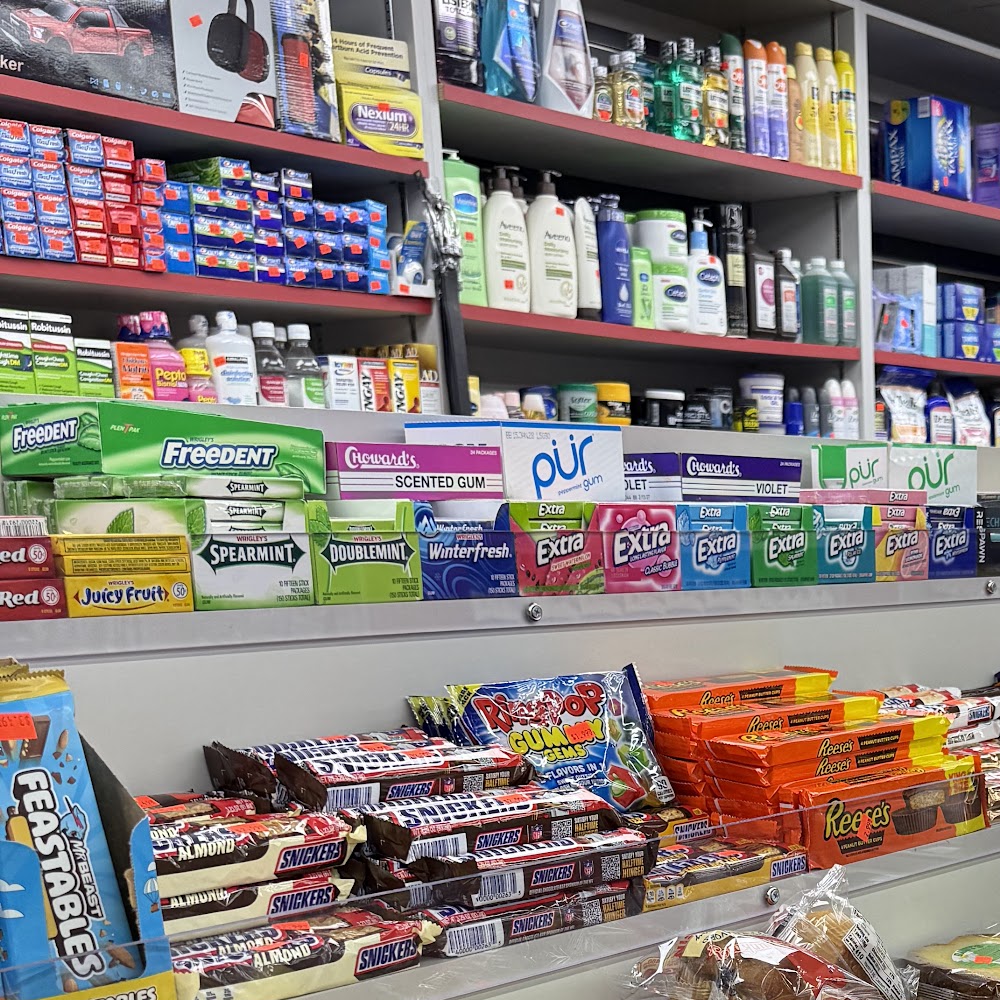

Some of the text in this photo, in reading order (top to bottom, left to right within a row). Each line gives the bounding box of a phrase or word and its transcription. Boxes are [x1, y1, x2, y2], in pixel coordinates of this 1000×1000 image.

[355, 46, 404, 59] Acid Prevention
[366, 42, 394, 52] Frequent
[364, 66, 392, 76] Capsules
[357, 104, 408, 122] Nexium
[32, 125, 57, 135] Colgate
[71, 131, 97, 141] Colgate
[32, 161, 58, 170] Colgate
[69, 165, 94, 175] Colgate
[4, 188, 32, 198] Colgate
[37, 193, 63, 203] Colgate
[7, 223, 33, 232] Colgate
[31, 322, 72, 335] Robitussin
[76, 348, 111, 359] Robitussin
[154, 368, 187, 383] Pepto
[229, 482, 266, 494] SPEARMINT
[395, 475, 486, 489] SCENTED GUM
[583, 474, 604, 492] gum
[756, 484, 788, 495] VIOLET
[890, 492, 908, 502] Extra
[229, 506, 263, 518] SPEARMINT
[539, 503, 566, 516] Extra
[700, 506, 721, 518] Extra
[887, 508, 905, 517] Extra
[615, 521, 672, 566] Extra
[831, 531, 864, 556] Extra
[887, 531, 919, 556] Extra
[937, 531, 967, 556] Extra
[976, 511, 987, 563] RESPAWN
[210, 543, 295, 566] SPEARMINT
[330, 542, 406, 563] DOUBLEMINT
[430, 543, 511, 562] Winterfresh
[537, 533, 584, 565] Extra
[698, 531, 736, 563] Extra
[769, 531, 805, 561] Extra
[644, 560, 678, 576] CLASSIC BUBBLE
[81, 586, 167, 605] Juicy Fruit
[700, 691, 735, 706] Reese's
[749, 715, 783, 732] Reese's
[543, 745, 587, 762] GEMS
[819, 738, 854, 757] Reese's
[547, 763, 598, 780] FLAVORS IN
[816, 758, 851, 777] Reese's
[388, 781, 433, 799] SNICKERS
[485, 777, 510, 788] HALFTIME
[574, 821, 599, 832] HALFTIME
[824, 798, 892, 841] Reese's
[675, 820, 711, 839] SNICKERS
[477, 829, 520, 849] SNICKERS
[872, 836, 883, 844] CUPS
[178, 840, 236, 862] ALMOND
[280, 840, 343, 869] SNICKERS
[622, 857, 644, 869] HALFTIME
[771, 856, 806, 877] SNICKERS
[16, 771, 105, 979] FEASTABLES
[533, 863, 574, 886] SNICKERS
[622, 866, 644, 879] HUNGER
[170, 888, 226, 909] ALMOND
[271, 886, 333, 914] SNICKERS
[602, 901, 625, 912] HALFTIME
[512, 912, 554, 935] SNICKERS
[603, 909, 625, 922] HUNGER
[253, 943, 311, 968] ALMOND
[360, 936, 418, 969] SNICKERS
